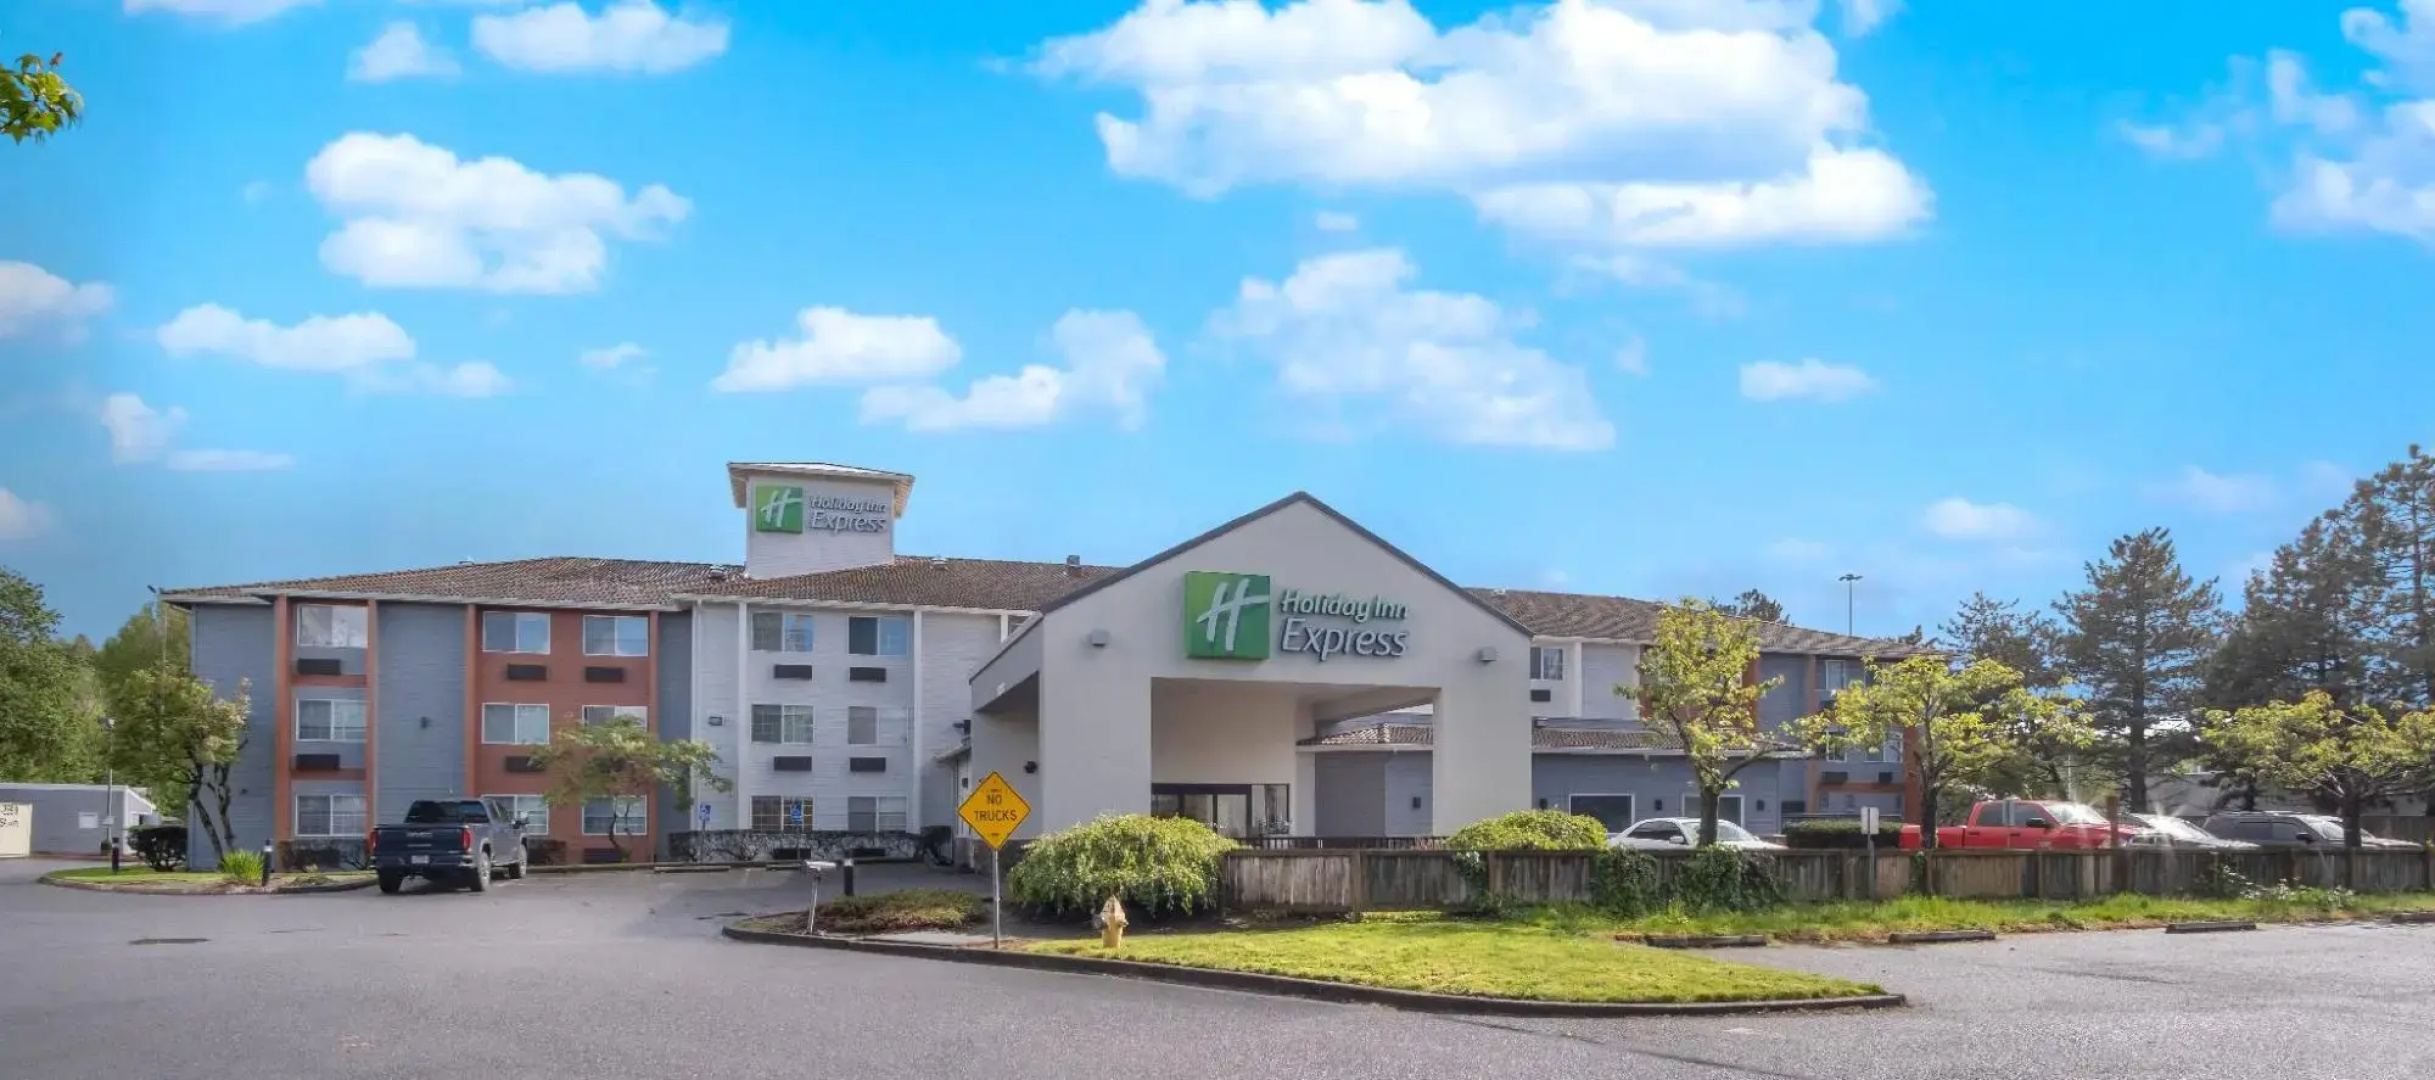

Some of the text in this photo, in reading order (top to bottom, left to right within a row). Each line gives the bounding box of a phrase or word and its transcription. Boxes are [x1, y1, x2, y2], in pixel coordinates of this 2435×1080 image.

[810, 496, 887, 514] Holiday Inn
[810, 511, 887, 535] Express
[1281, 589, 1408, 622] Holiday Inn
[1281, 618, 1408, 661] Express
[986, 794, 1003, 805] NO
[974, 809, 1018, 822] TRUCKS
